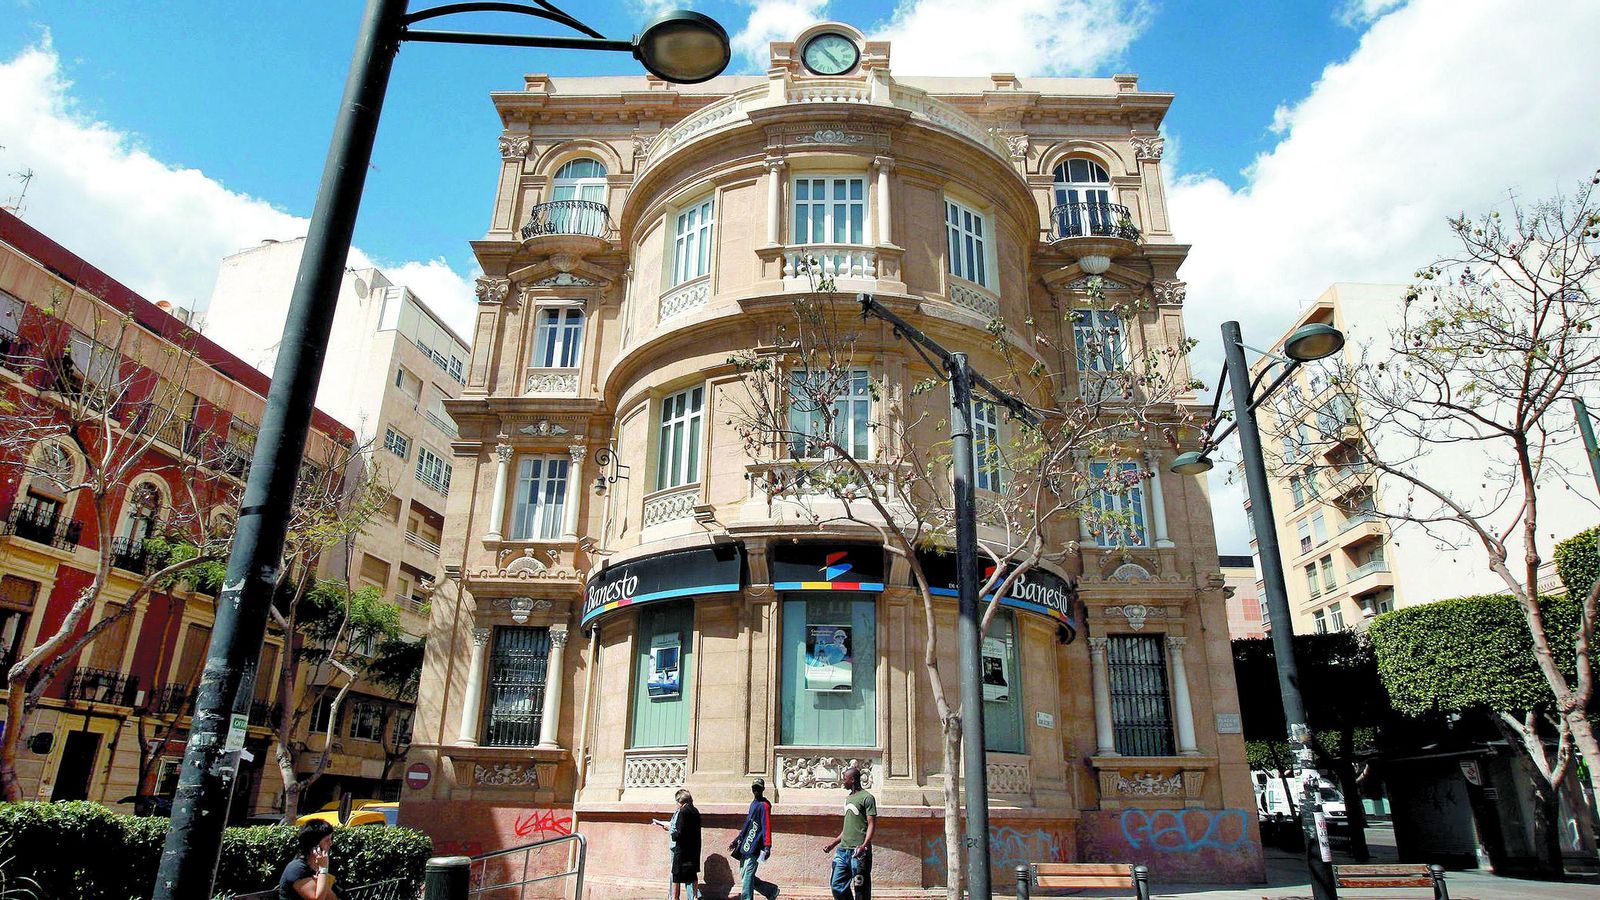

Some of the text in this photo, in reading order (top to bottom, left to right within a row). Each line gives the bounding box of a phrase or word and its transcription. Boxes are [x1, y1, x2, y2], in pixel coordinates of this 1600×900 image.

[587, 569, 638, 613] Banesto
[1011, 573, 1068, 618] Banesto
[743, 821, 758, 852] POLO
